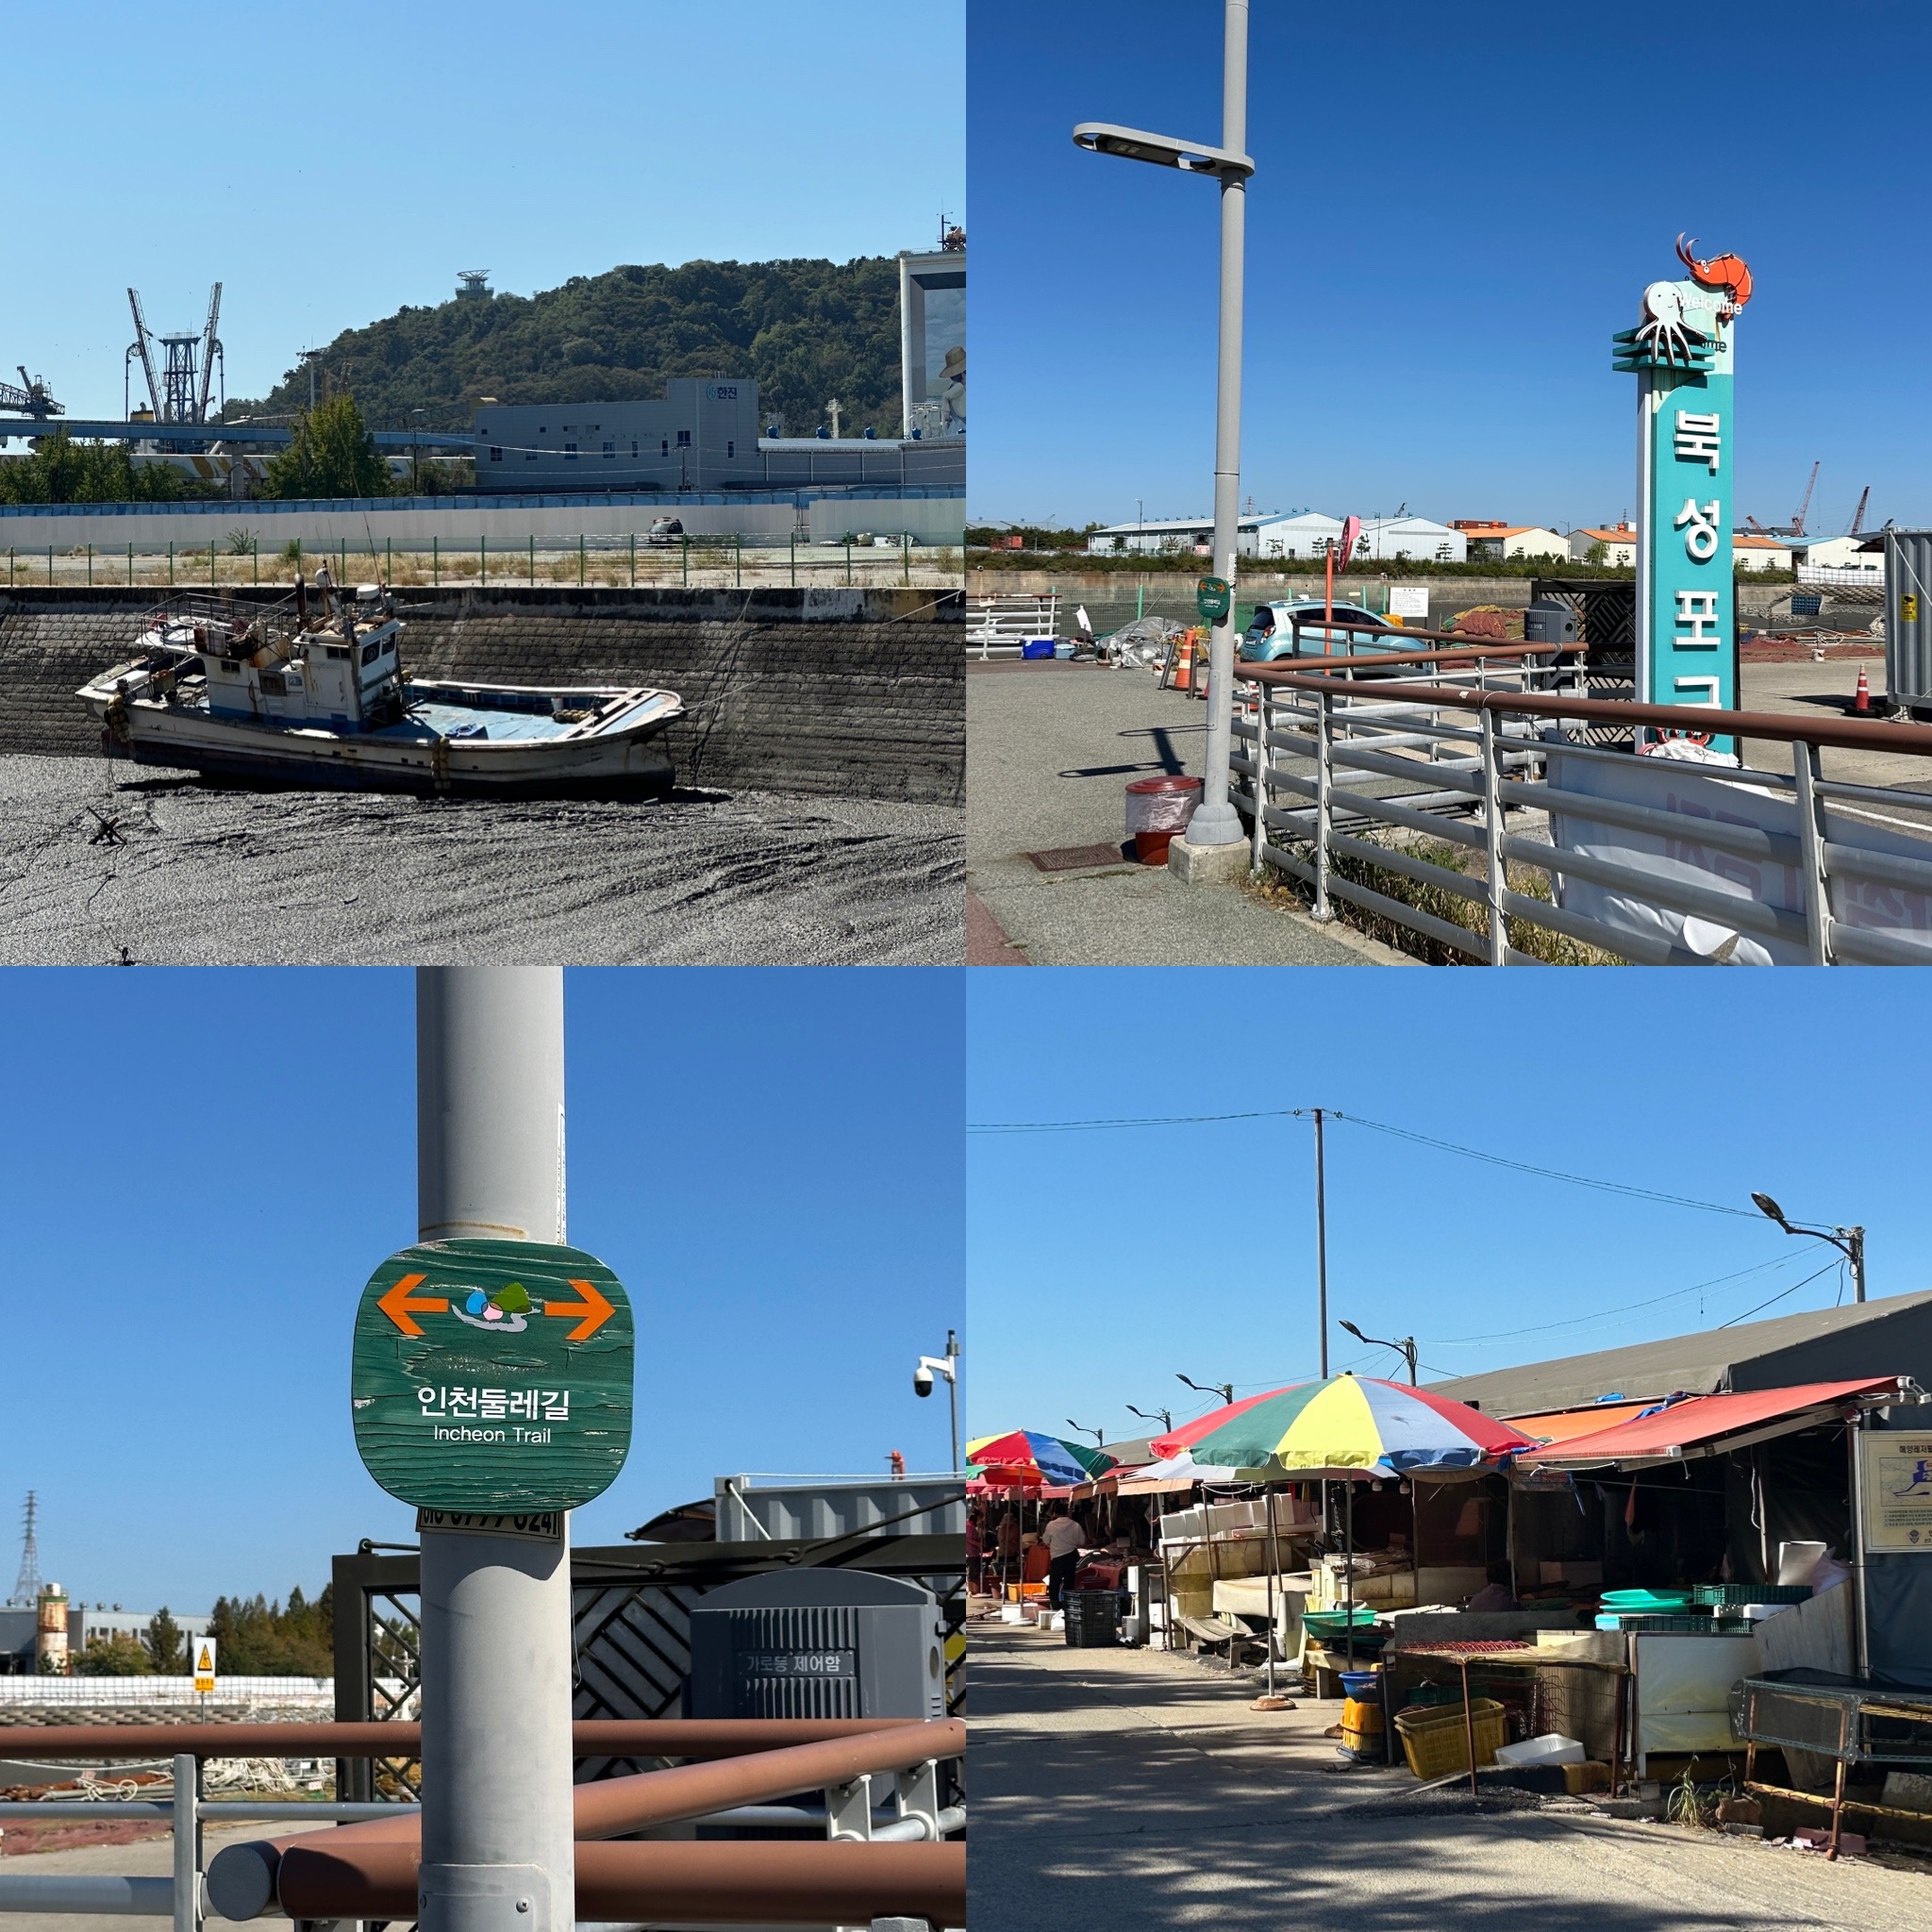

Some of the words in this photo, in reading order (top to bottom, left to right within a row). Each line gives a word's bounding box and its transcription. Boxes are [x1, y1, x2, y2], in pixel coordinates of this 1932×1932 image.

[1678, 291, 1743, 315] Welcome
[717, 386, 738, 400] 한진
[1673, 409, 1722, 710] 북성포구
[417, 1386, 570, 1422] 인천둘레길
[434, 1424, 506, 1442] Incheon
[512, 1426, 552, 1443] Trail
[747, 1655, 789, 1673] 가로등
[793, 1655, 841, 1673] 제어함
